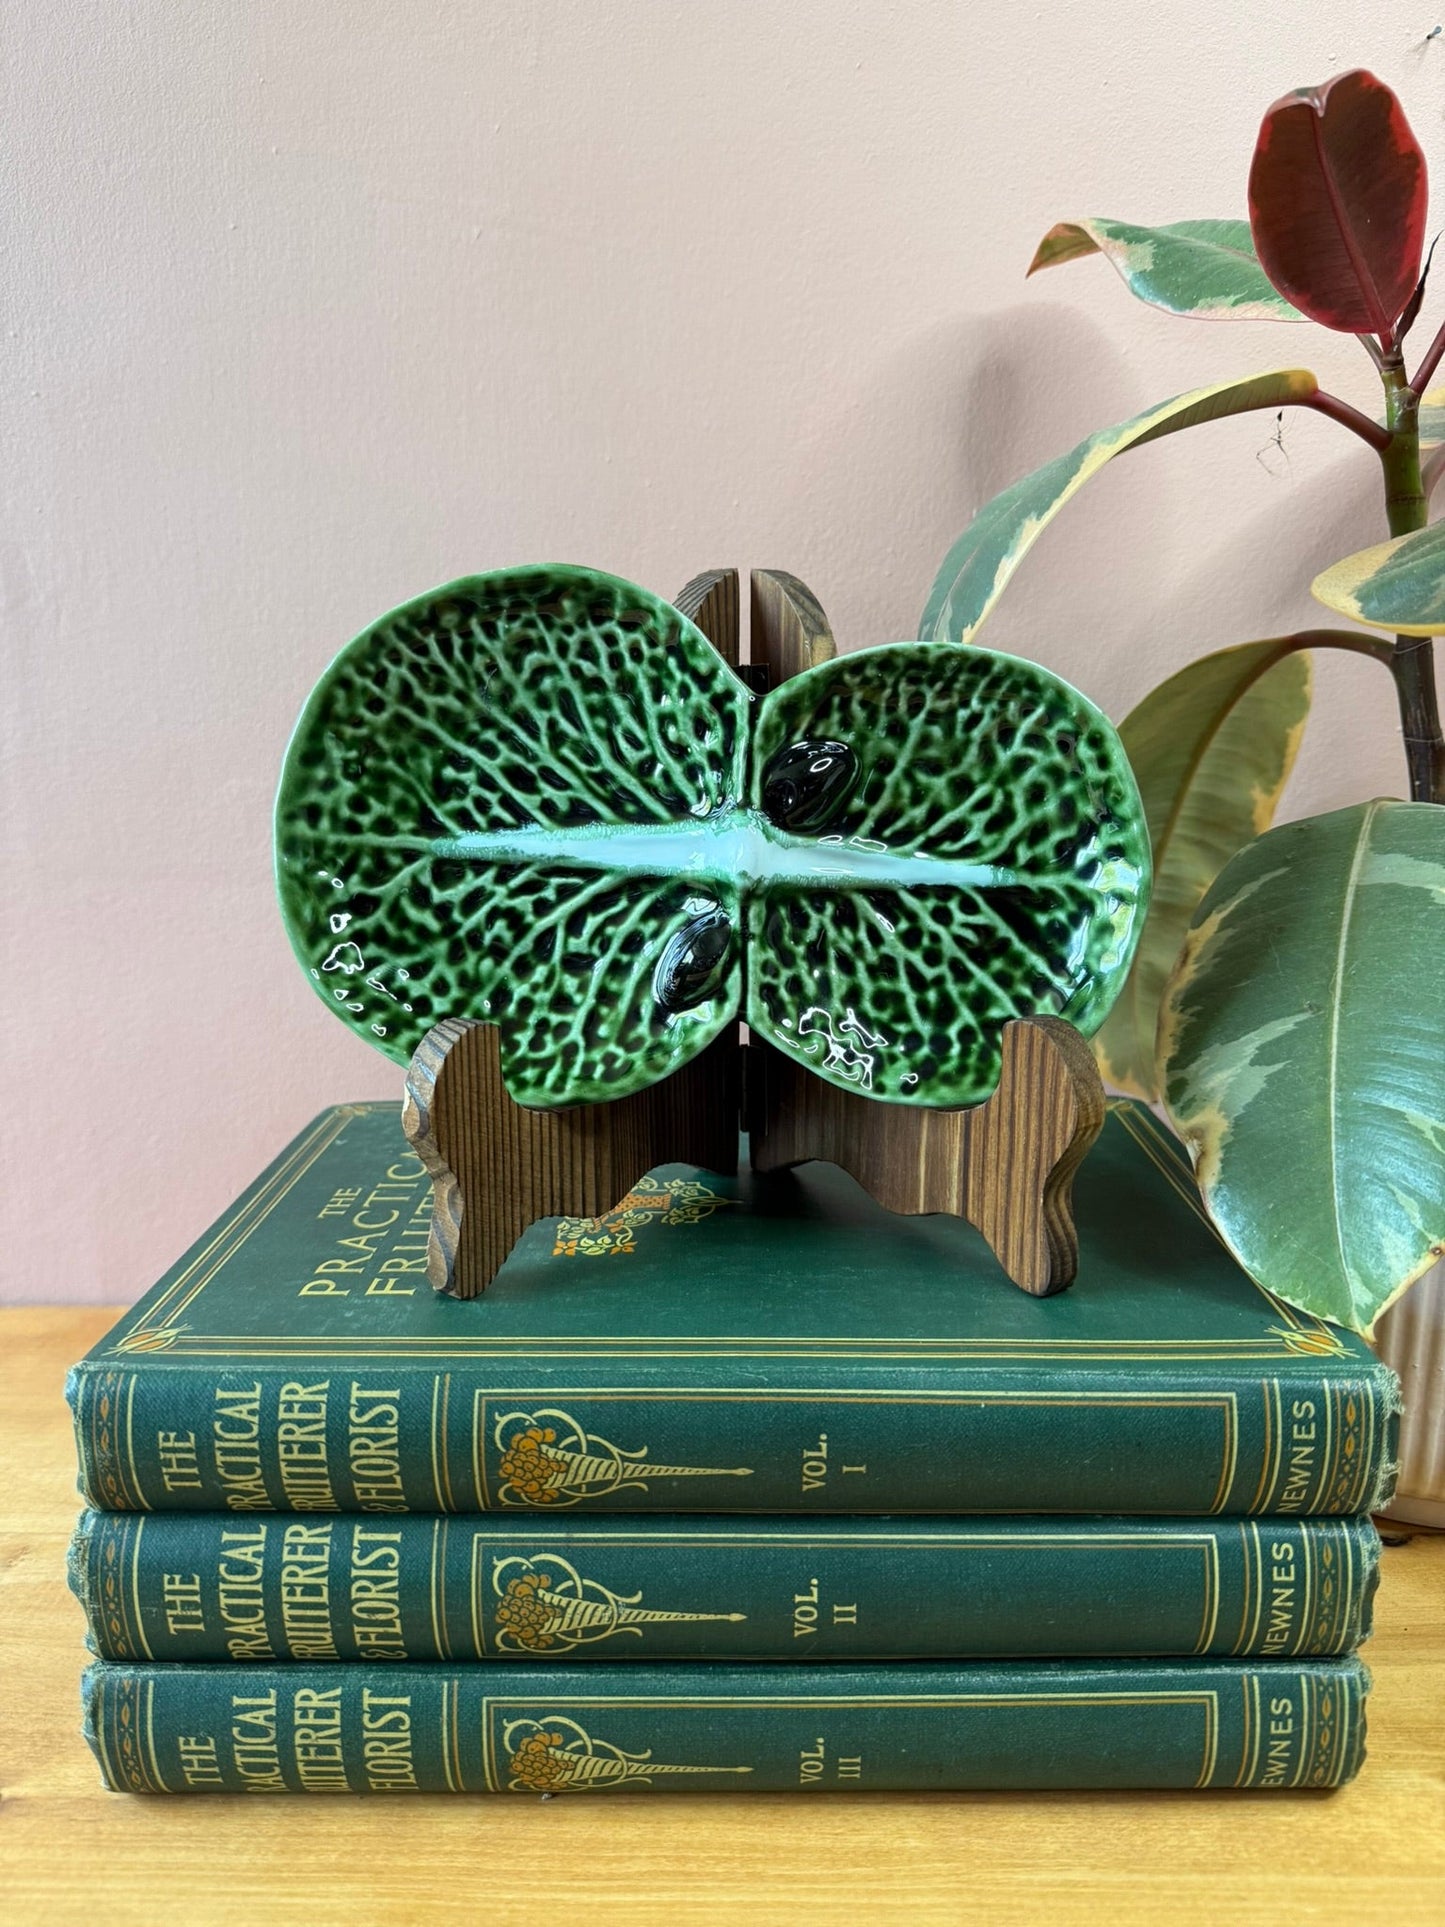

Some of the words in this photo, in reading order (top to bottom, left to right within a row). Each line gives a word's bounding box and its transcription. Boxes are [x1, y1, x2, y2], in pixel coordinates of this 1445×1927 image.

[298, 1150, 429, 1296] PRACTIC
[317, 1187, 362, 1219] THE
[158, 1430, 203, 1492] THE
[213, 1381, 278, 1512] PRACTICAL
[277, 1379, 342, 1512] FRUITERER
[802, 1433, 828, 1492] VOL.
[842, 1464, 867, 1474] I
[1275, 1399, 1316, 1513] NEWNES
[163, 1573, 205, 1635] THE
[218, 1523, 277, 1660] PRACTICAL
[280, 1522, 341, 1660] FRUITERER
[794, 1578, 819, 1637] VOL.
[833, 1603, 857, 1624] II
[1259, 1541, 1296, 1654] NEWNES
[178, 1735, 223, 1785] THE
[232, 1688, 292, 1792] RACTICAL
[800, 1737, 825, 1784] VOL.
[838, 1755, 862, 1779] III
[1260, 1696, 1294, 1785] EWNES
